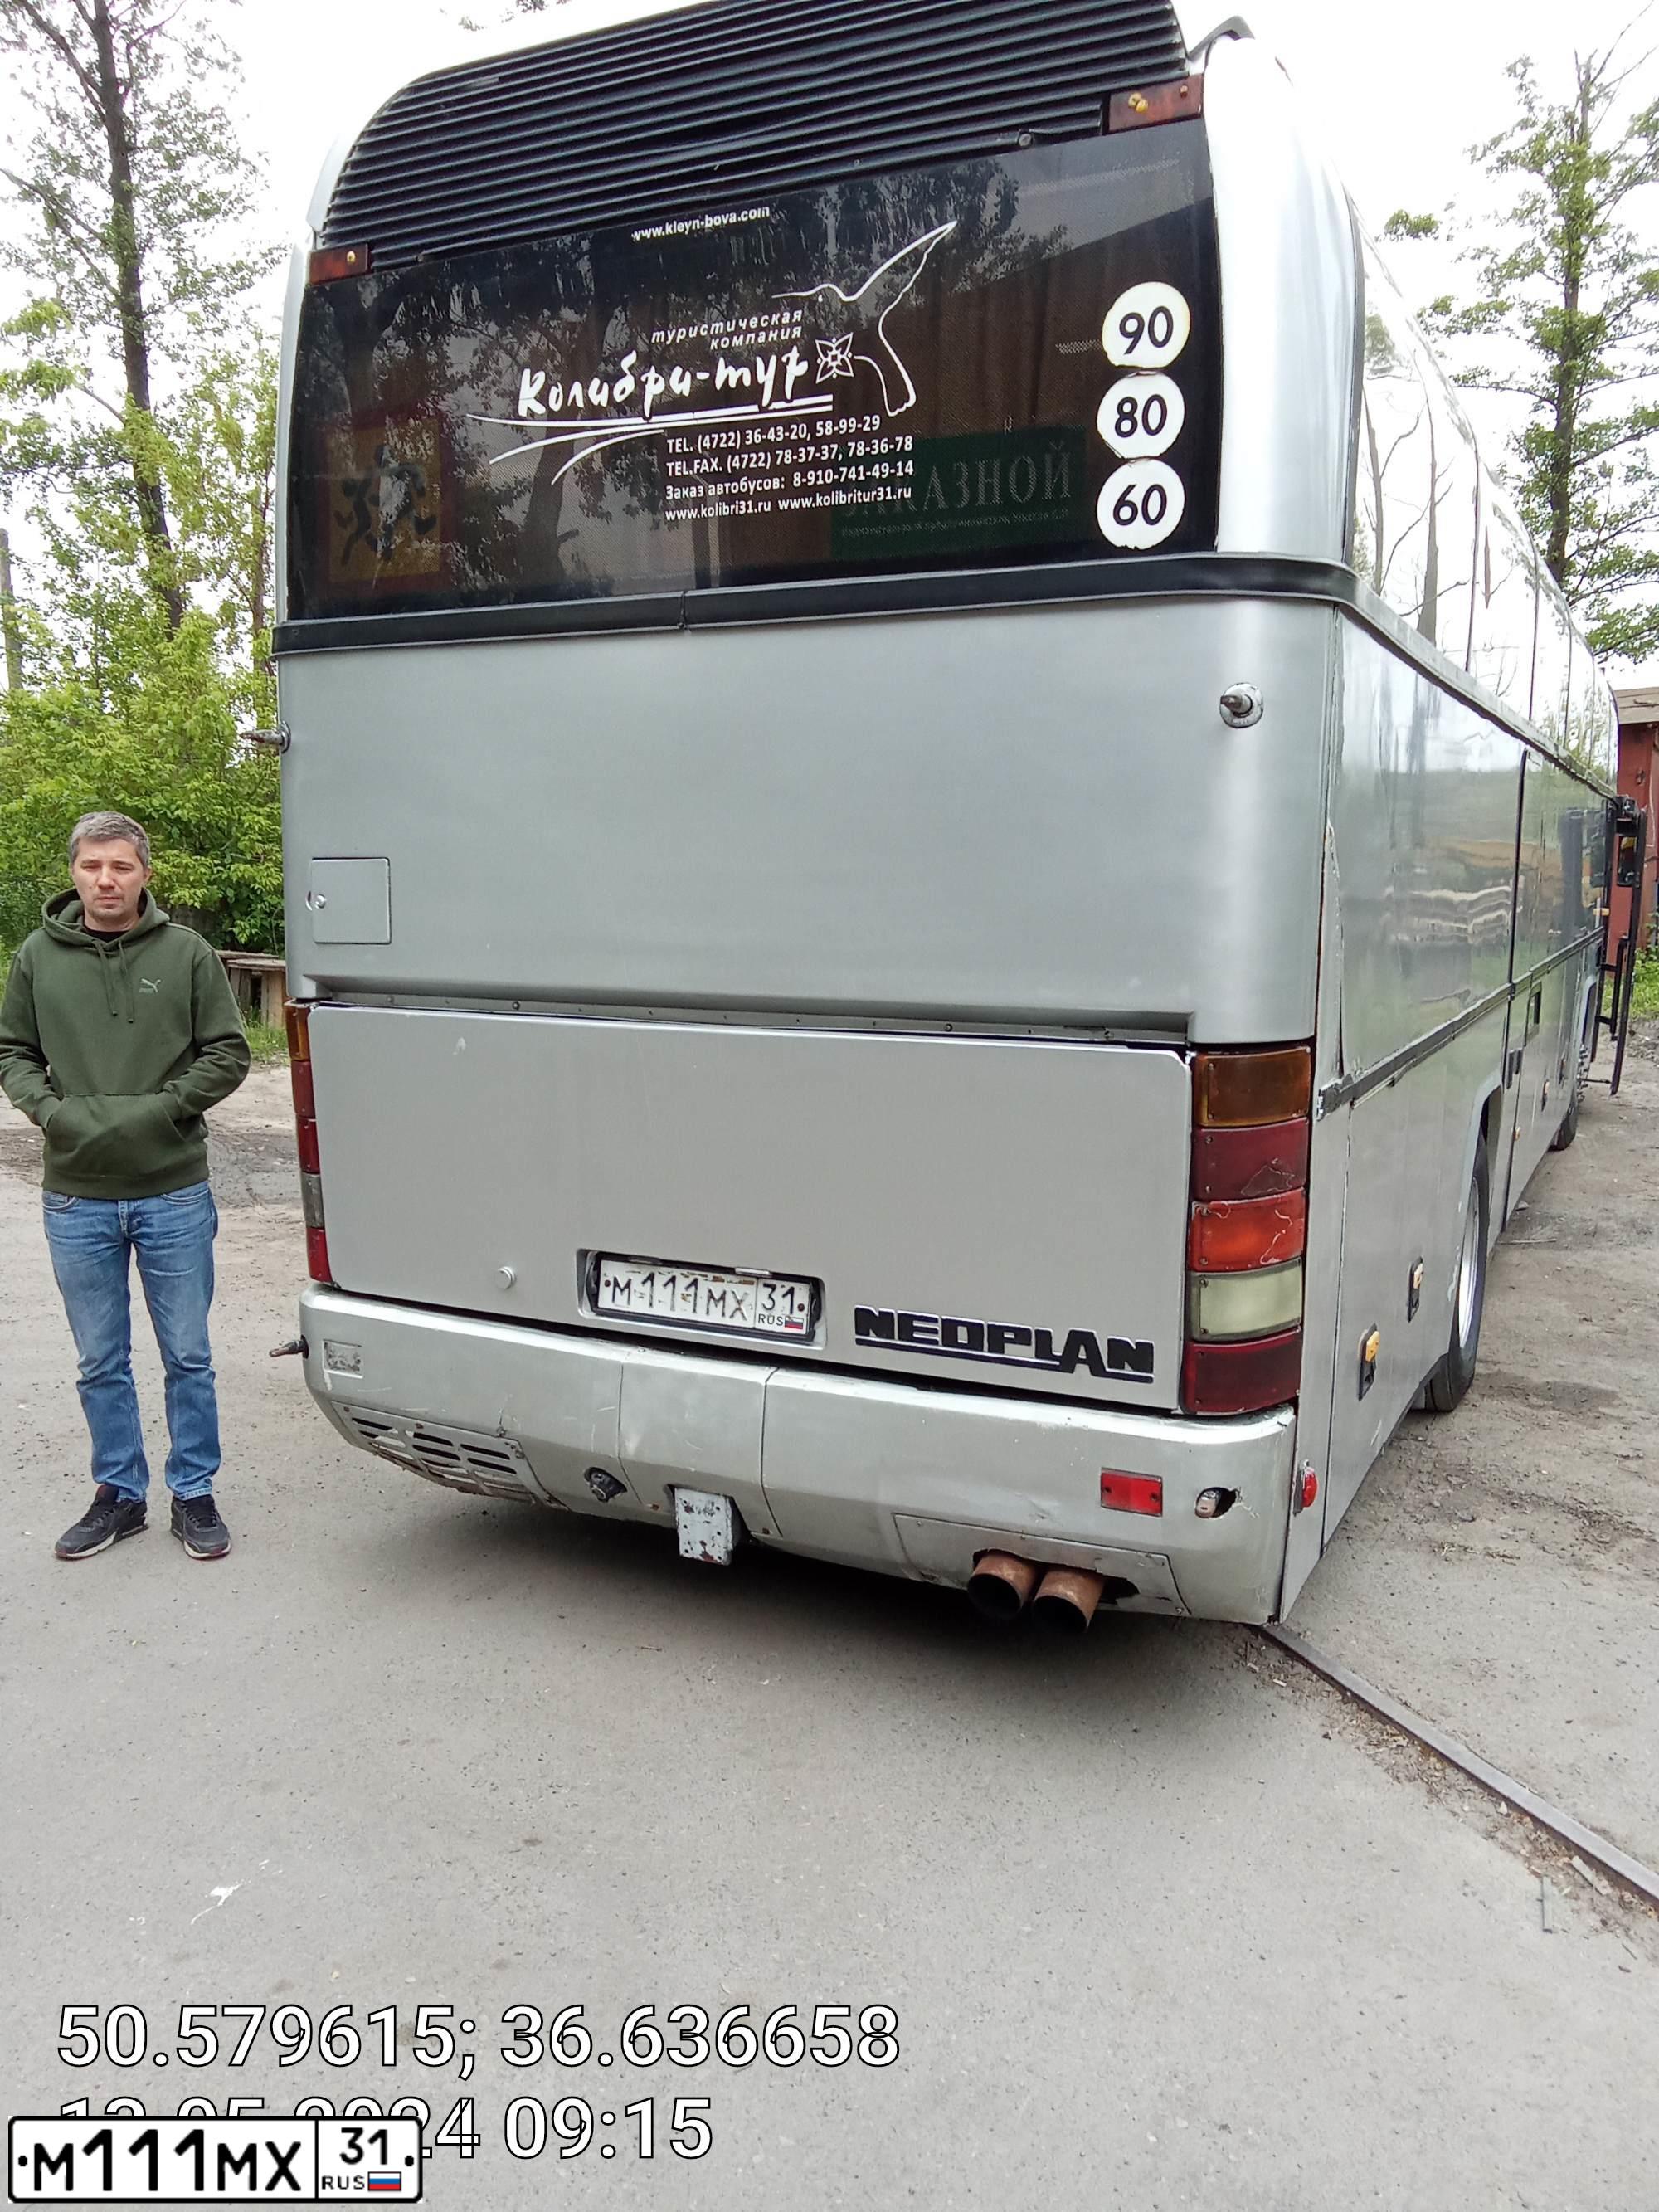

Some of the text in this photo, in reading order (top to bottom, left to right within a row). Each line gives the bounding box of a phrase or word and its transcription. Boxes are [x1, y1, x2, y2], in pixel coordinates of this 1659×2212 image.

[630, 205, 771, 241] www.kleyn-bova.com
[650, 309, 803, 344] туристическая
[709, 325, 802, 351] компания
[1118, 305, 1174, 355] 90
[518, 344, 809, 417] Колибри-тур
[666, 414, 881, 454] TEL. (4722) 36-43-20, 58-99-29
[1114, 393, 1168, 438] 80
[666, 435, 914, 477] TEL.FAX. (4722) 78-37-37, 78-36-78
[665, 459, 914, 500] Заказ автобусов: 8-910-741-49-14
[664, 485, 912, 521] www.kolibri31.ru www.kolibritur31.ru
[1112, 484, 1168, 526] 60
[761, 1283, 795, 1315] 31
[757, 1313, 784, 1327] RUS
[854, 1305, 1155, 1383] NEOPLAN
